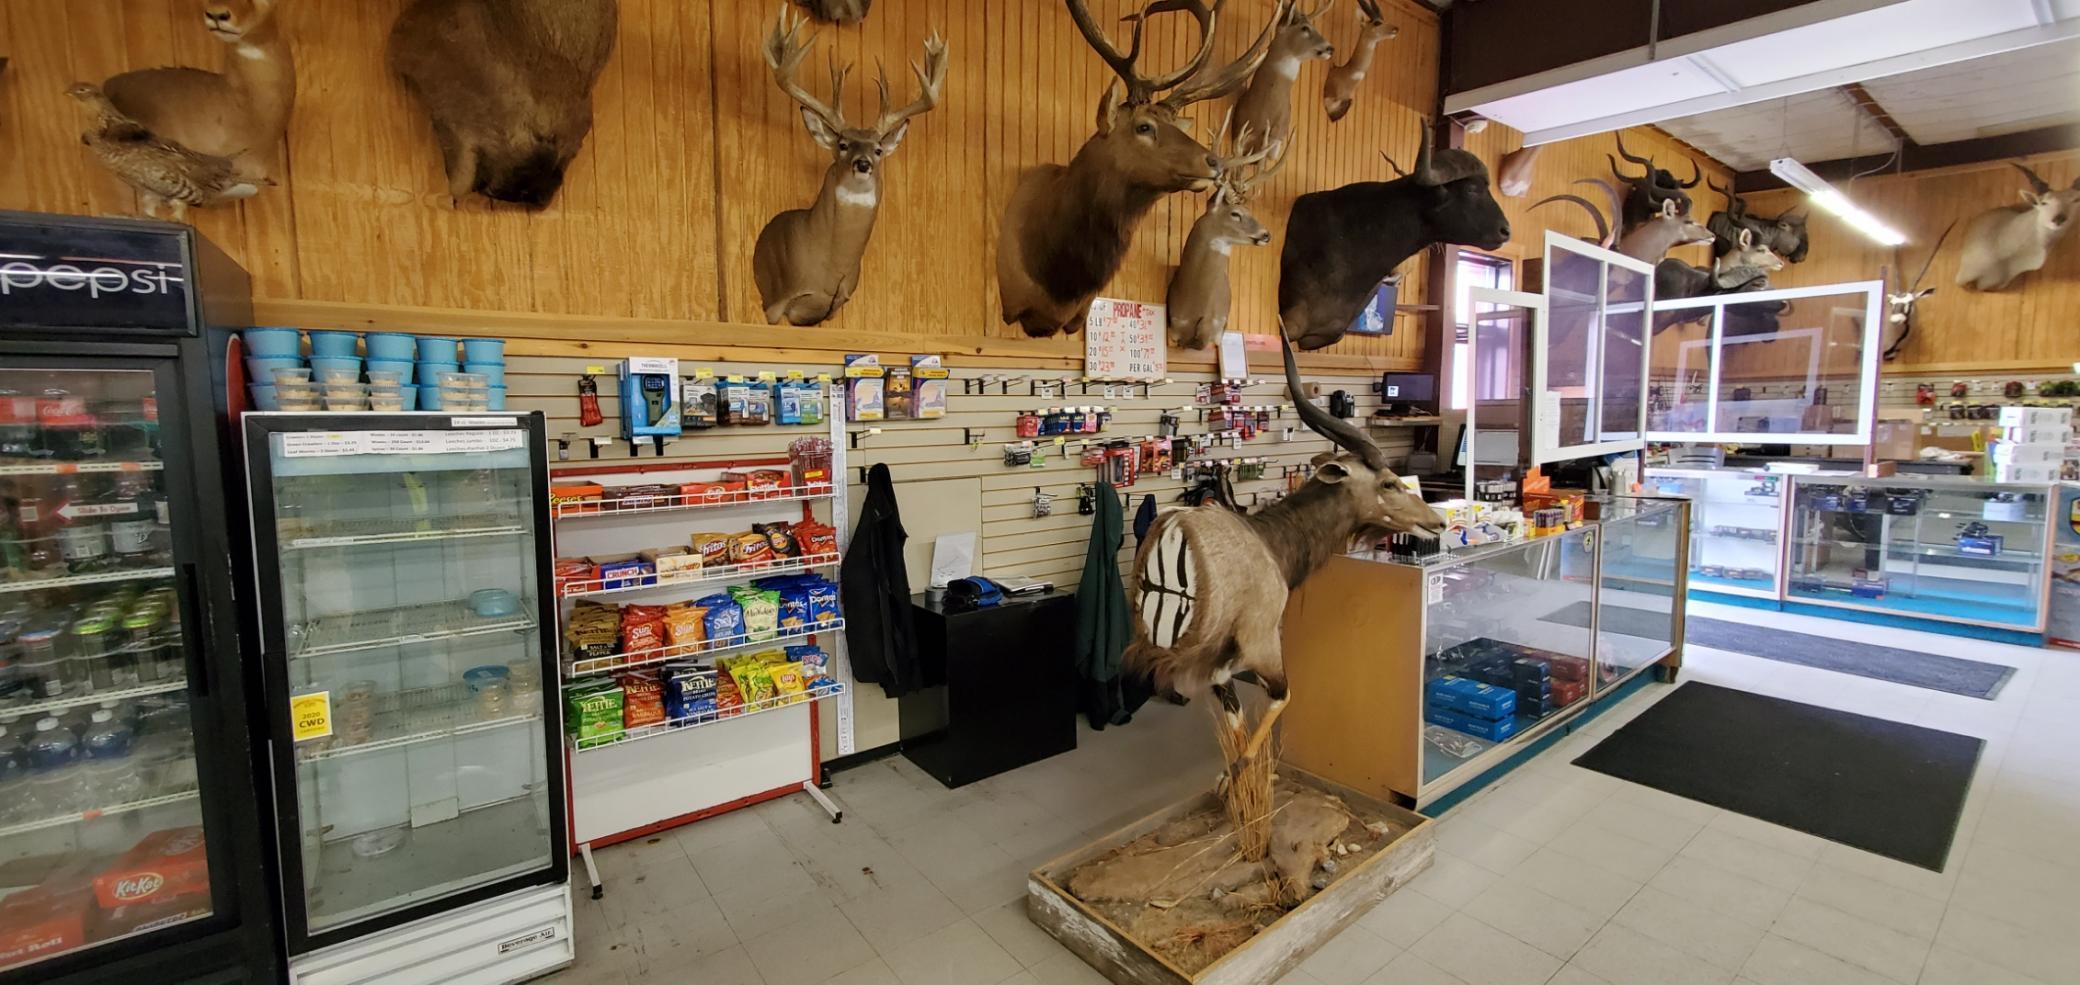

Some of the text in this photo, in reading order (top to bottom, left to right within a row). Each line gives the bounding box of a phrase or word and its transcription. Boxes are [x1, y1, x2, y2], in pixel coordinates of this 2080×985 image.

[1, 262, 168, 299] pepsi
[1113, 302, 1142, 318] PROPANE
[1129, 320, 1137, 329] 40
[1091, 332, 1098, 341] 10
[1129, 334, 1137, 344] 50
[1089, 346, 1098, 356] 20
[1130, 349, 1140, 358] 100
[1089, 362, 1098, 371] 30
[1129, 363, 1140, 372] PER
[1143, 364, 1153, 373] GAL
[607, 569, 639, 579] CRUNCH
[632, 626, 652, 639] Sun
[676, 623, 695, 636] Sun
[299, 718, 325, 728] CWD
